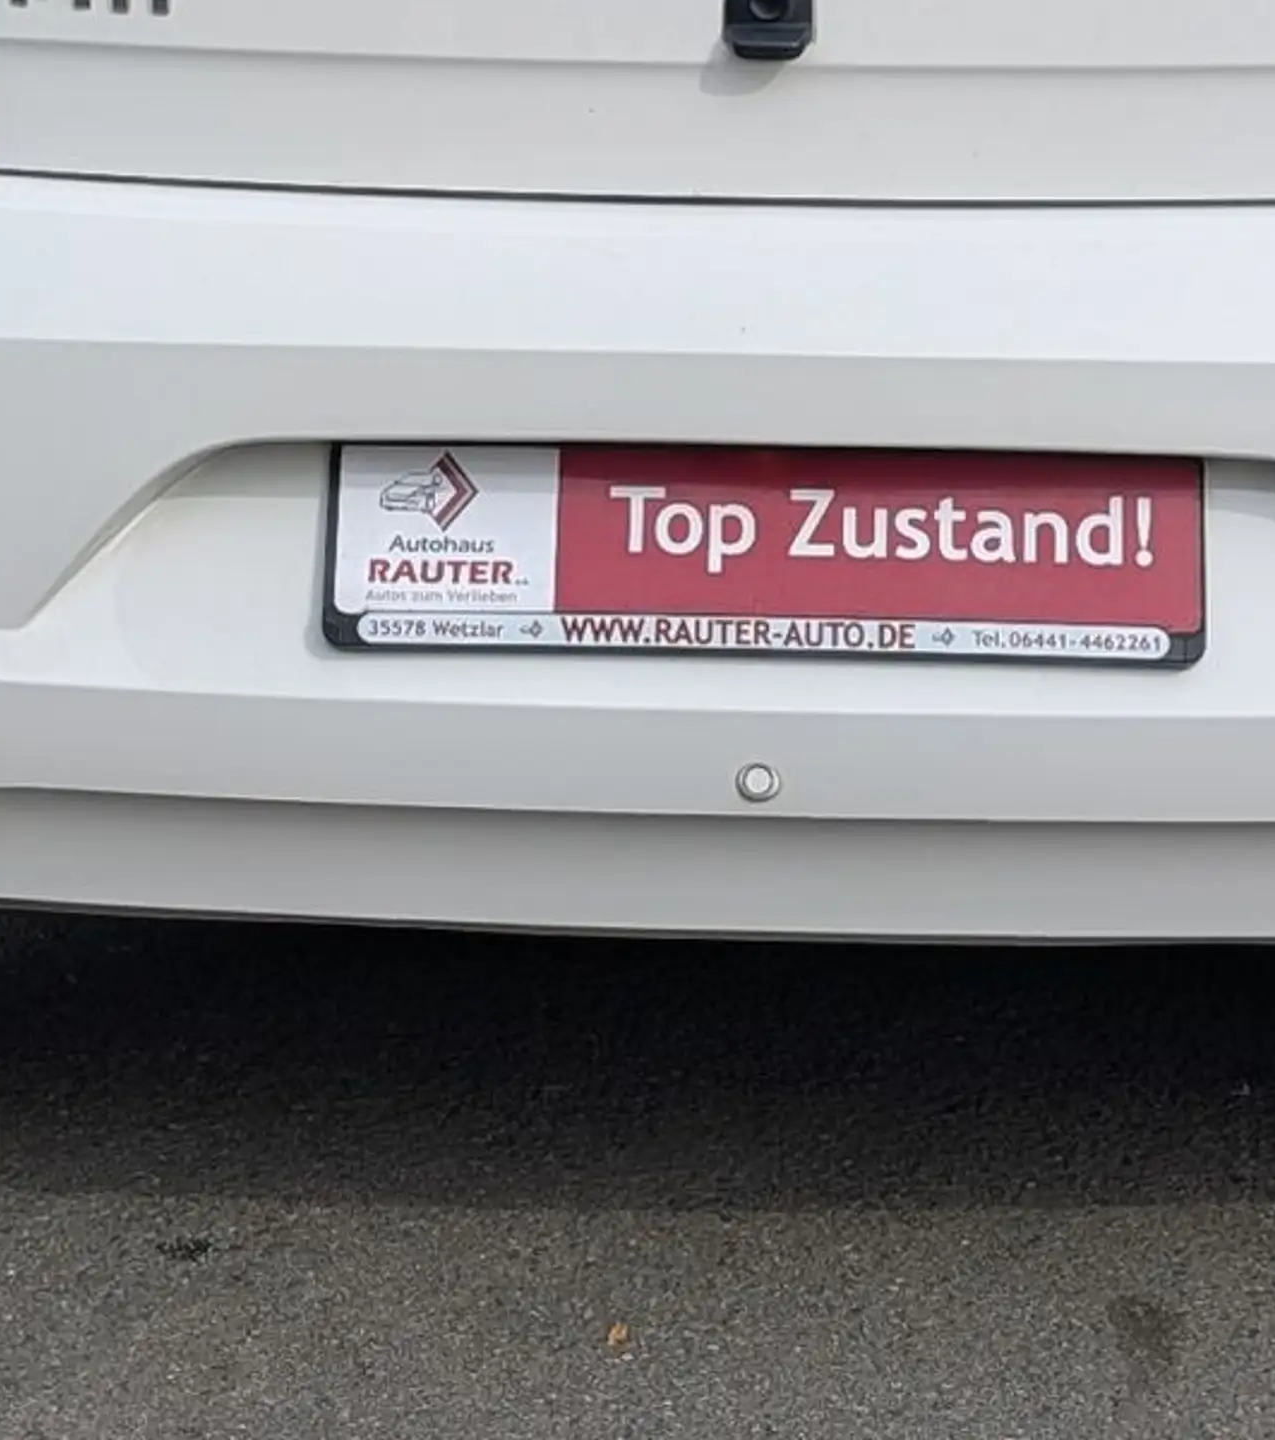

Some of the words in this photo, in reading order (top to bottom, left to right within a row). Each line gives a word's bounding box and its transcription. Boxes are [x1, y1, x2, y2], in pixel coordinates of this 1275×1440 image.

[611, 486, 755, 573] Top
[789, 489, 1153, 568] Zustand!
[388, 534, 495, 554] Autohaus
[367, 558, 514, 585] RAUTER
[365, 589, 406, 602] Autos
[413, 592, 443, 602] zum
[448, 590, 517, 604] Verlieben
[368, 619, 426, 637] 35578
[432, 621, 504, 638] Wetzlar
[562, 618, 916, 650] WWW.RAUTER-AUTO.DE
